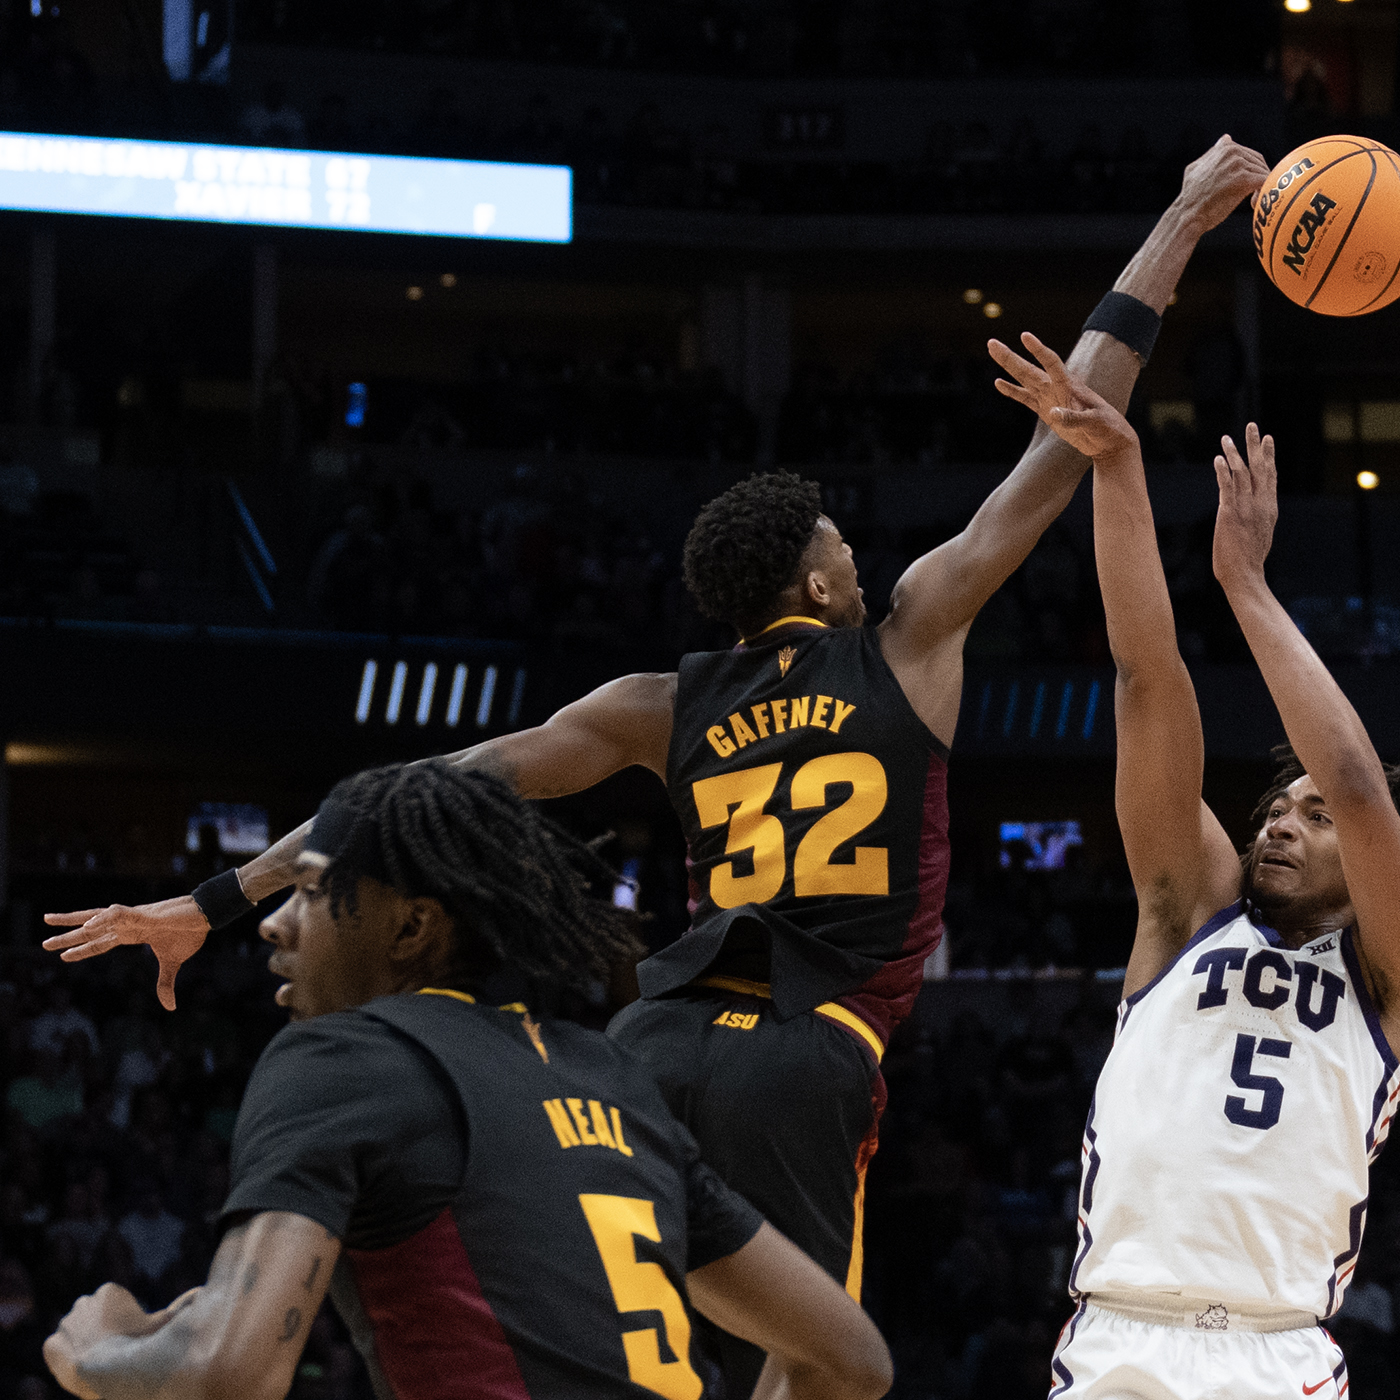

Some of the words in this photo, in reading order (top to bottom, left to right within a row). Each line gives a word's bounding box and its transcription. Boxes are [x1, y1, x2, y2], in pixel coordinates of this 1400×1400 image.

[192, 149, 313, 188] STATE
[1282, 192, 1338, 277] NCAA
[705, 694, 858, 759] GAFFNEY
[692, 751, 890, 910] 32
[712, 1010, 759, 1031] ASU
[1191, 947, 1346, 1033] TCU
[1223, 1033, 1293, 1131] 5
[542, 1097, 634, 1159] NEAL
